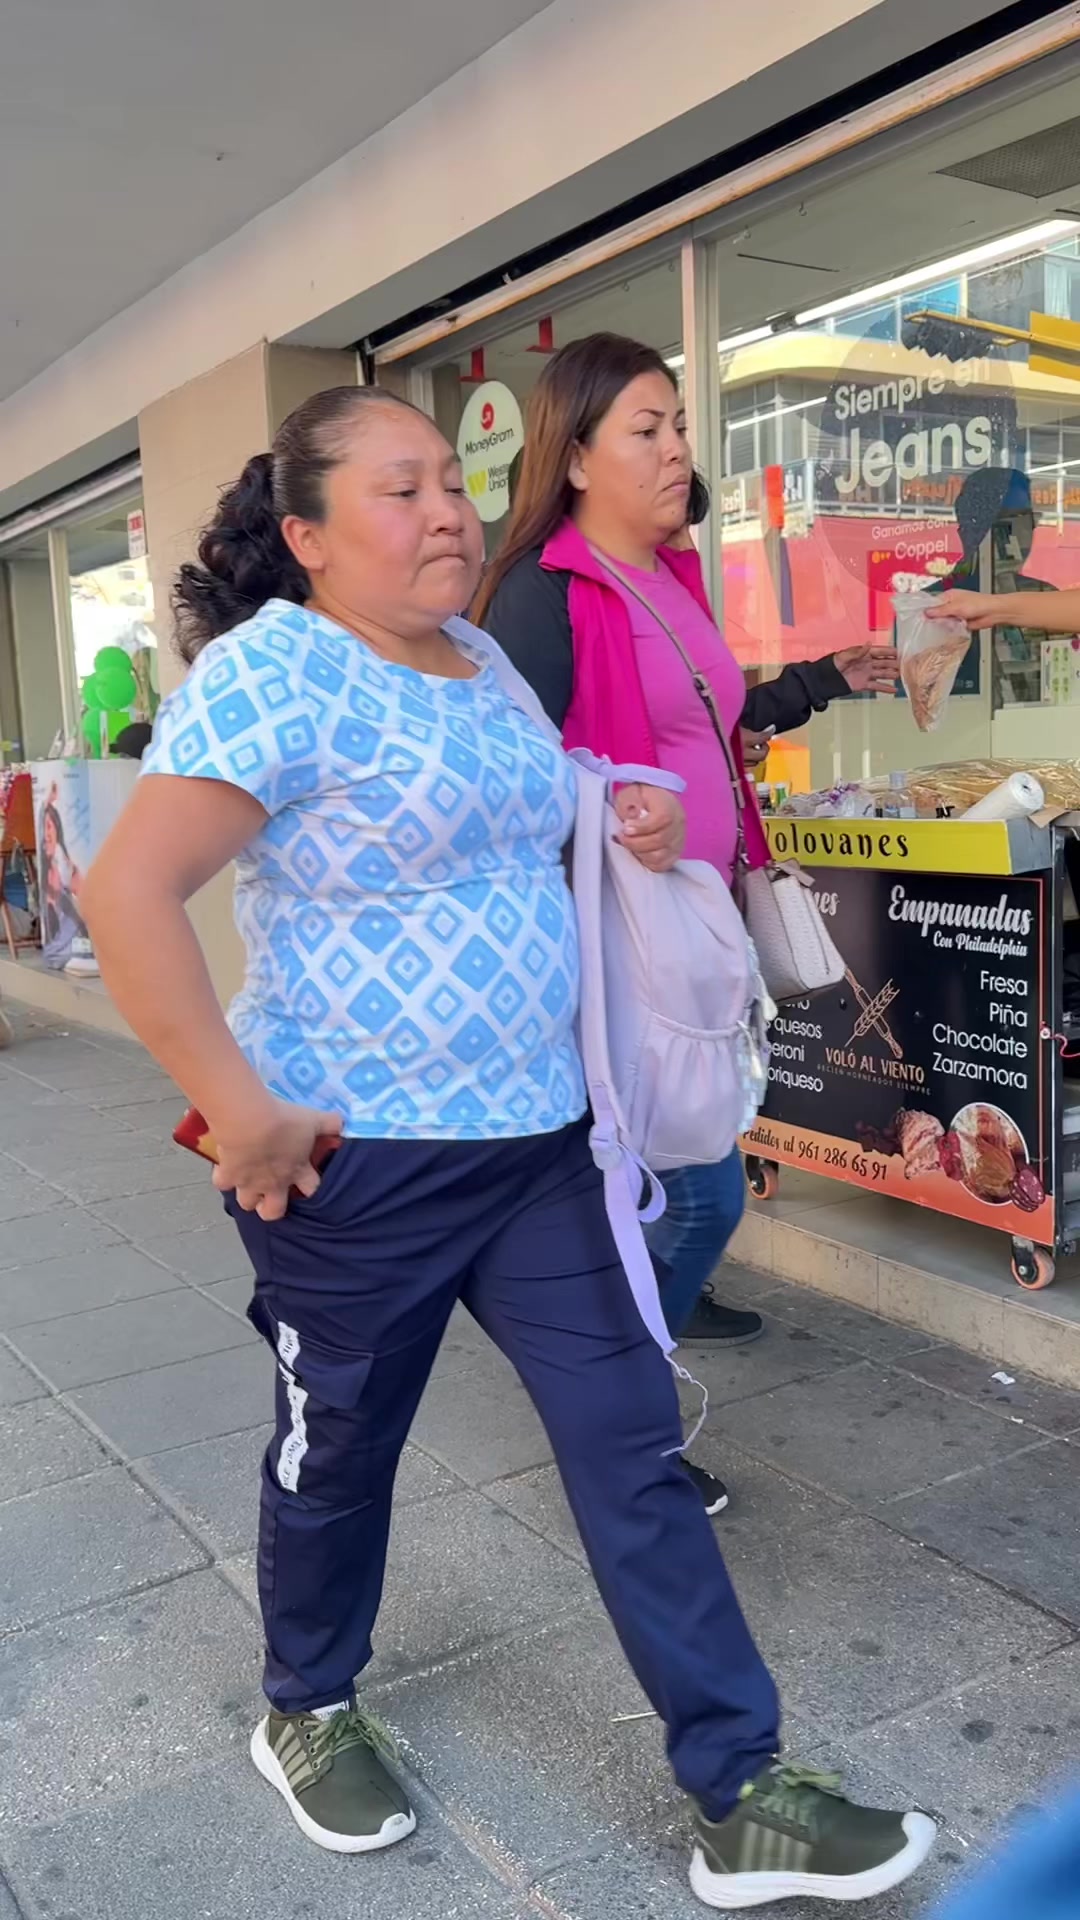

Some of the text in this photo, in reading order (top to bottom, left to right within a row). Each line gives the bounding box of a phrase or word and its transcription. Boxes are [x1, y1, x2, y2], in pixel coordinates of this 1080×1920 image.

[834, 357, 990, 421] Siempre en
[465, 428, 515, 457] MoneyGram
[834, 416, 992, 494] Jeans
[488, 477, 508, 492] Unio
[871, 520, 924, 540] Ganamos
[894, 533, 949, 561] Coppel
[888, 884, 1034, 938] Empanadas
[933, 930, 1028, 960] Con Philadelphia
[980, 970, 1028, 996] Fresa
[774, 1017, 823, 1039] quesos
[989, 1002, 1028, 1027] Piña
[767, 1042, 805, 1062] eroni
[932, 1023, 1028, 1058] Chocolate
[767, 1066, 823, 1092] oriqueso
[825, 1047, 925, 1084] VOLÓ AL VIENTO
[932, 1052, 1027, 1090] Zarzamora
[783, 1136, 795, 1153] al
[798, 1140, 819, 1161] 961
[824, 1147, 847, 1169] 286
[851, 1154, 867, 1177] 65
[872, 1161, 887, 1180] 91
